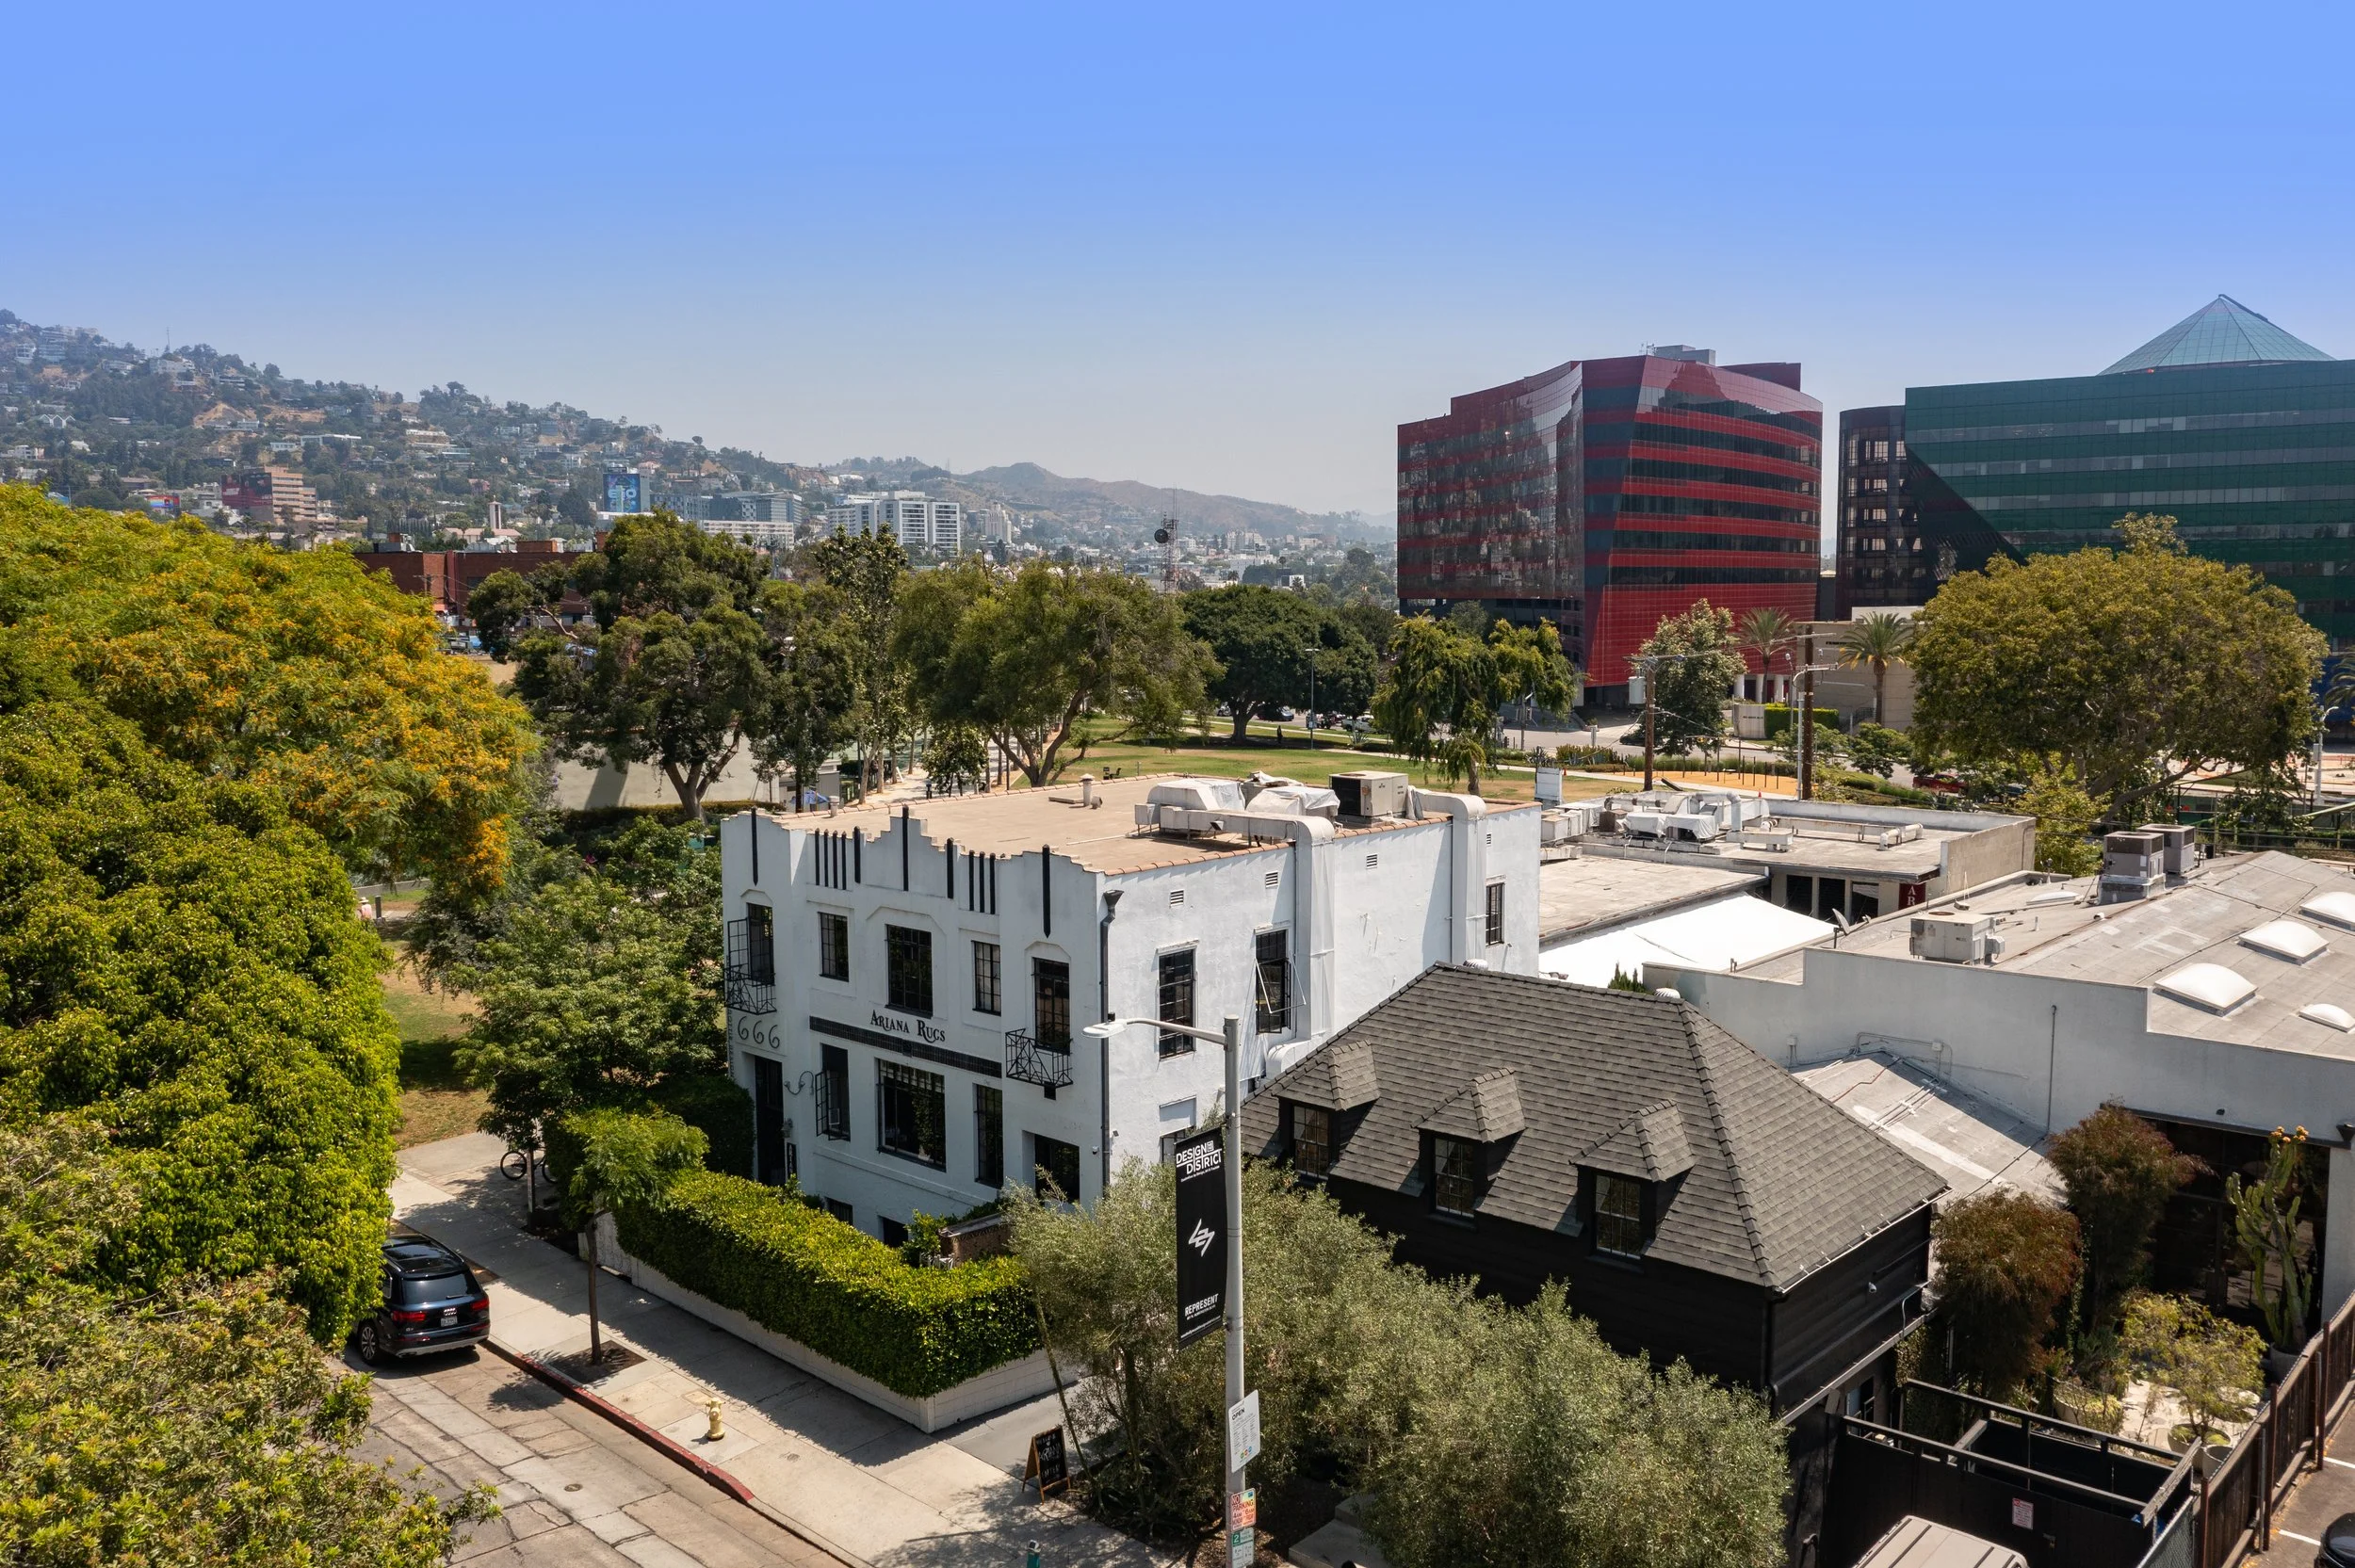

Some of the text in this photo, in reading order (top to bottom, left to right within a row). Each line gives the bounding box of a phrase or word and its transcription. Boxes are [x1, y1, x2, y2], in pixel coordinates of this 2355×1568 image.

[738, 1016, 780, 1049] 666
[870, 1010, 946, 1043] ARIANA RUGS
[1176, 1142, 1208, 1165] DESIGN
[1186, 1148, 1223, 1175] DISTRICT
[1184, 1293, 1219, 1317] REPRESENT
[1231, 1407, 1245, 1421] OPEN
[1232, 1495, 1240, 1506] NO
[1232, 1498, 1254, 1512] PARKING
[1233, 1534, 1240, 1544] 2
